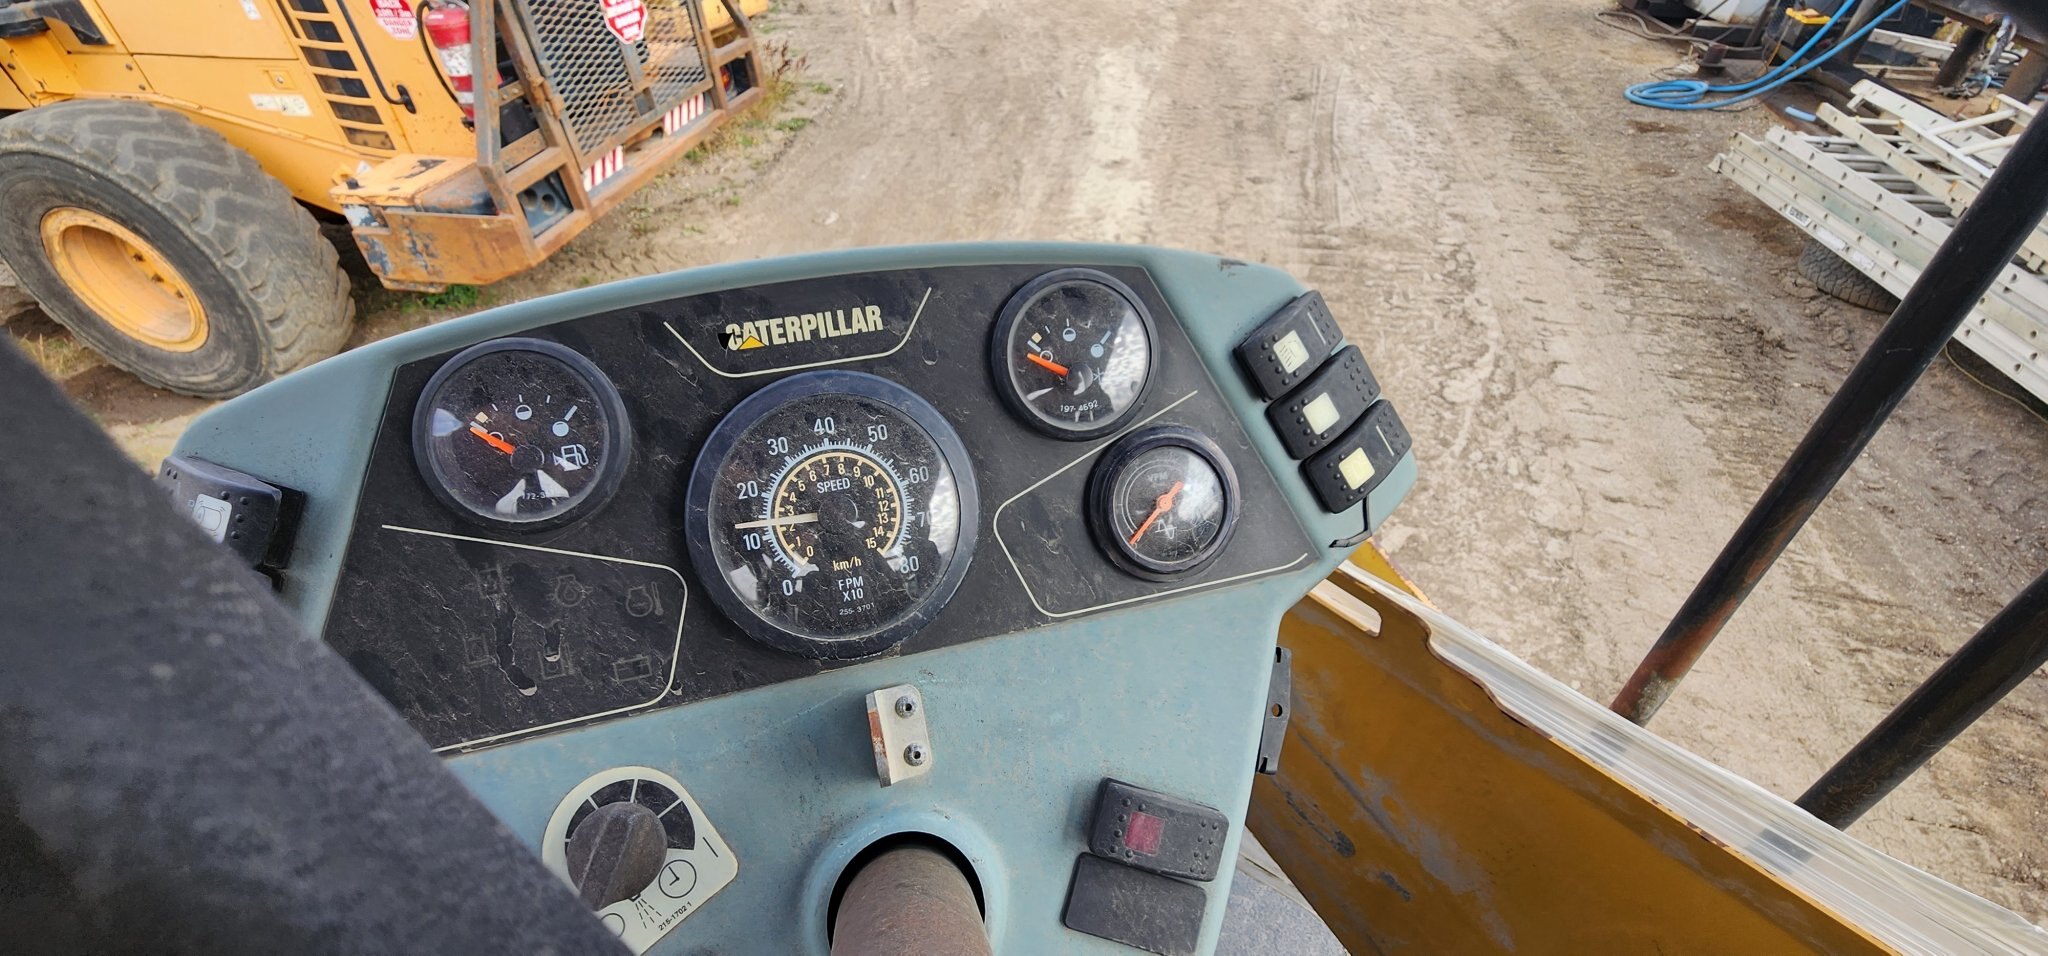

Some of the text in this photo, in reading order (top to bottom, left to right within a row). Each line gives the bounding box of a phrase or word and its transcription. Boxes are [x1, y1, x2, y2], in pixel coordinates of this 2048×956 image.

[725, 304, 884, 351] CATERPILLAR
[813, 416, 835, 436] 40
[867, 424, 888, 443] 50
[767, 437, 789, 456] 30
[823, 464, 830, 476] 7
[837, 463, 845, 475] 8
[853, 466, 861, 478] 9
[909, 466, 929, 484] 60
[809, 470, 817, 482] 6
[863, 474, 875, 488] 10
[736, 480, 759, 500] 20
[797, 480, 806, 492] 5
[816, 477, 851, 494] SPEED
[789, 491, 797, 503] 4
[875, 487, 885, 499] 11
[786, 505, 795, 516] 3
[878, 500, 890, 512] 12
[877, 512, 889, 525] 13
[872, 525, 885, 538] 14
[743, 532, 761, 551] 10
[795, 536, 801, 547] 1
[865, 537, 877, 550] 15
[806, 545, 814, 557] 0
[832, 556, 862, 571] km/h
[900, 555, 920, 574] 80
[782, 579, 793, 596] 0
[838, 575, 864, 590] FPM
[842, 588, 864, 602] X10
